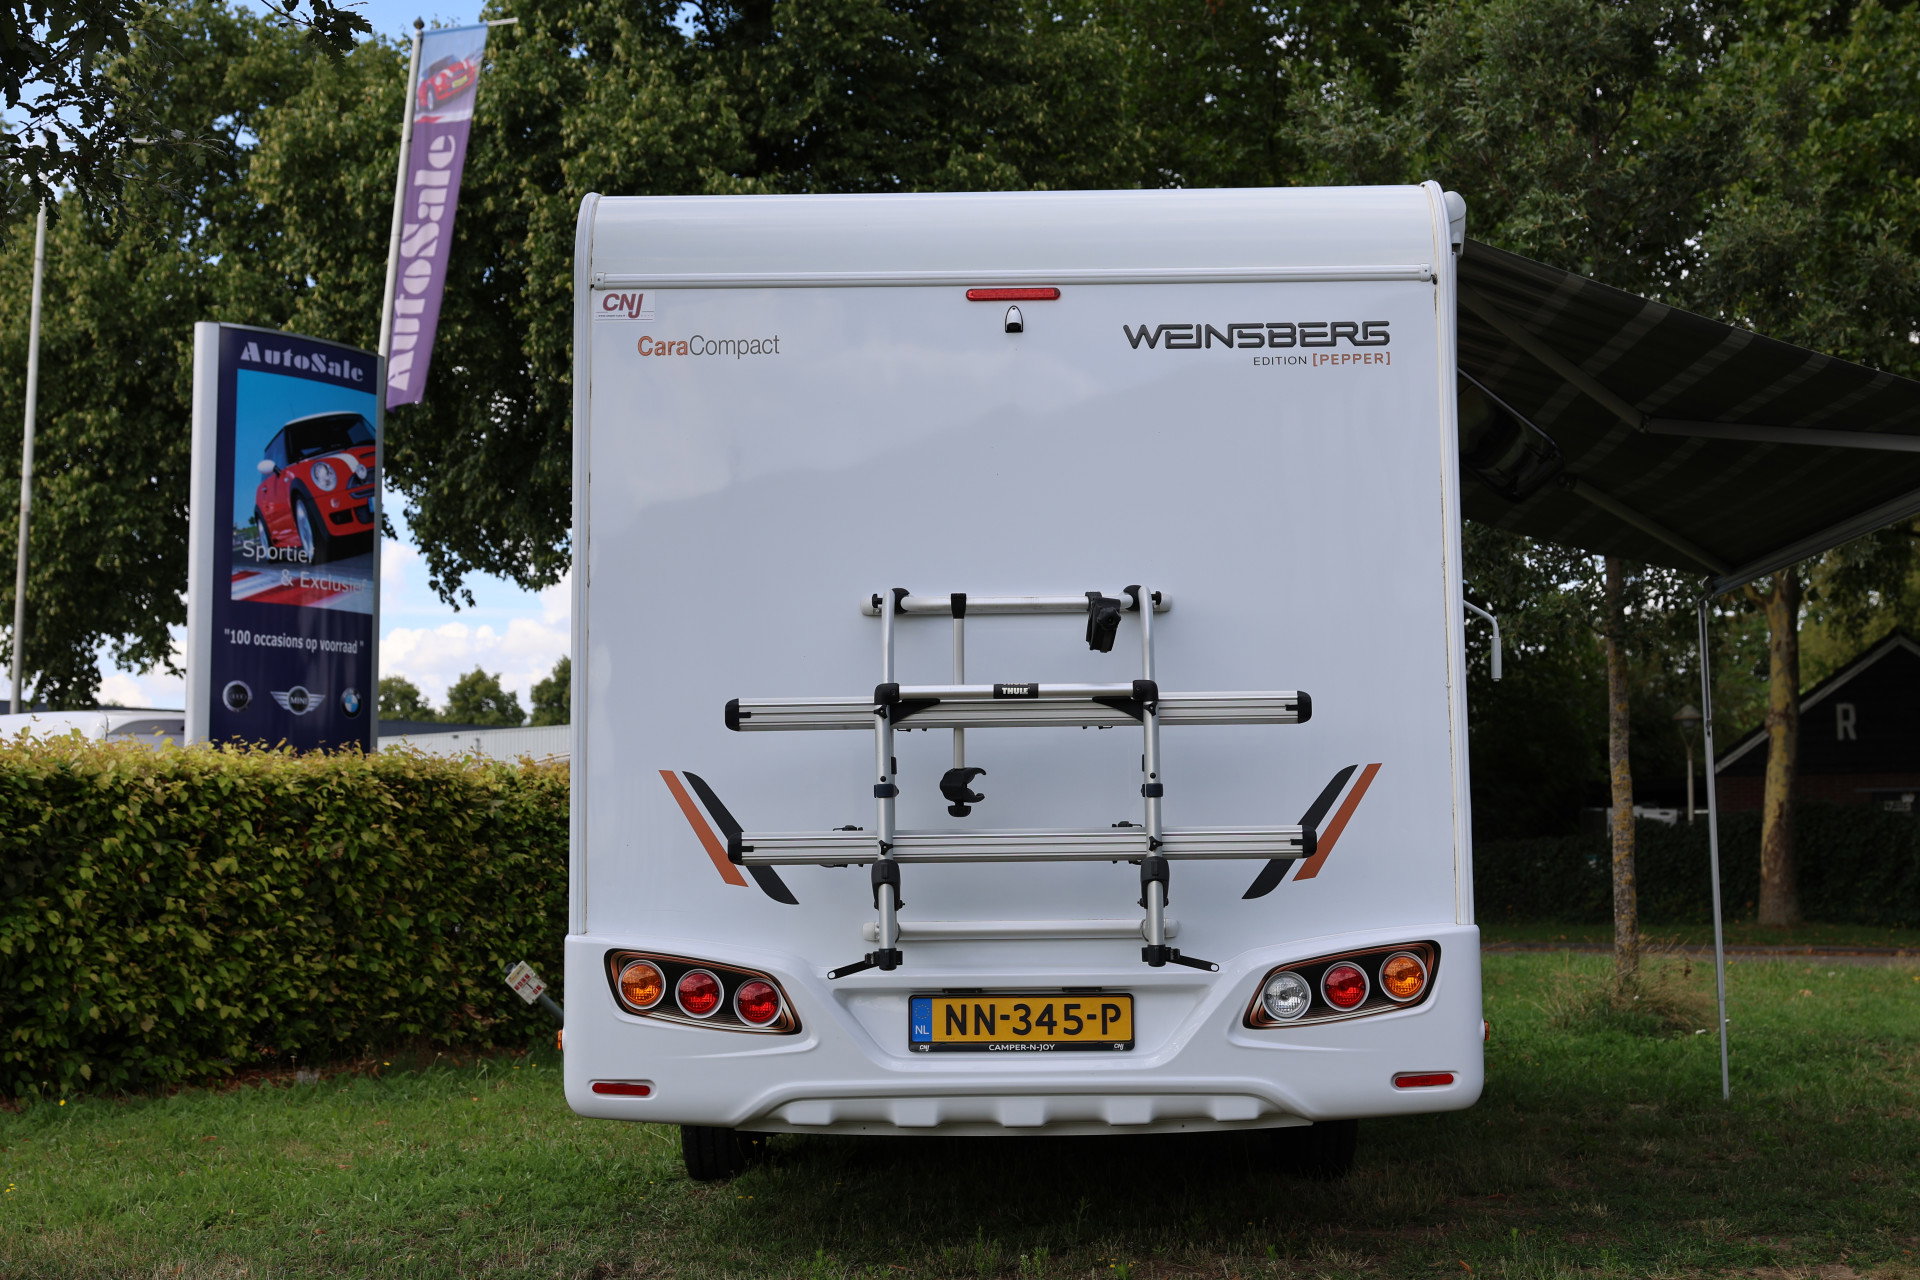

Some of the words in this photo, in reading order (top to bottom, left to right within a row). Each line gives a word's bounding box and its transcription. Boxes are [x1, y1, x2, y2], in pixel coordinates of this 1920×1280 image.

[387, 133, 456, 391] AutoSale
[602, 293, 644, 318] CNJ
[637, 334, 780, 359] CaraCompact
[1122, 320, 1391, 349] WEINSBERG
[240, 341, 364, 383] AutoSale
[1253, 355, 1307, 366] EDITION
[1312, 351, 1391, 367] [PEPPER]
[281, 568, 293, 587] &
[300, 571, 368, 593] Exclusief
[224, 628, 251, 645] "100
[253, 633, 304, 649] occasions
[305, 638, 318, 653] op
[1002, 687, 1029, 695] THULE
[1836, 703, 1857, 741] R
[915, 1025, 930, 1035] NL
[945, 1003, 1122, 1036] NN-345-P
[988, 1043, 1056, 1052] CAMPER-N-JOY
[1113, 1043, 1125, 1051] CNJ
